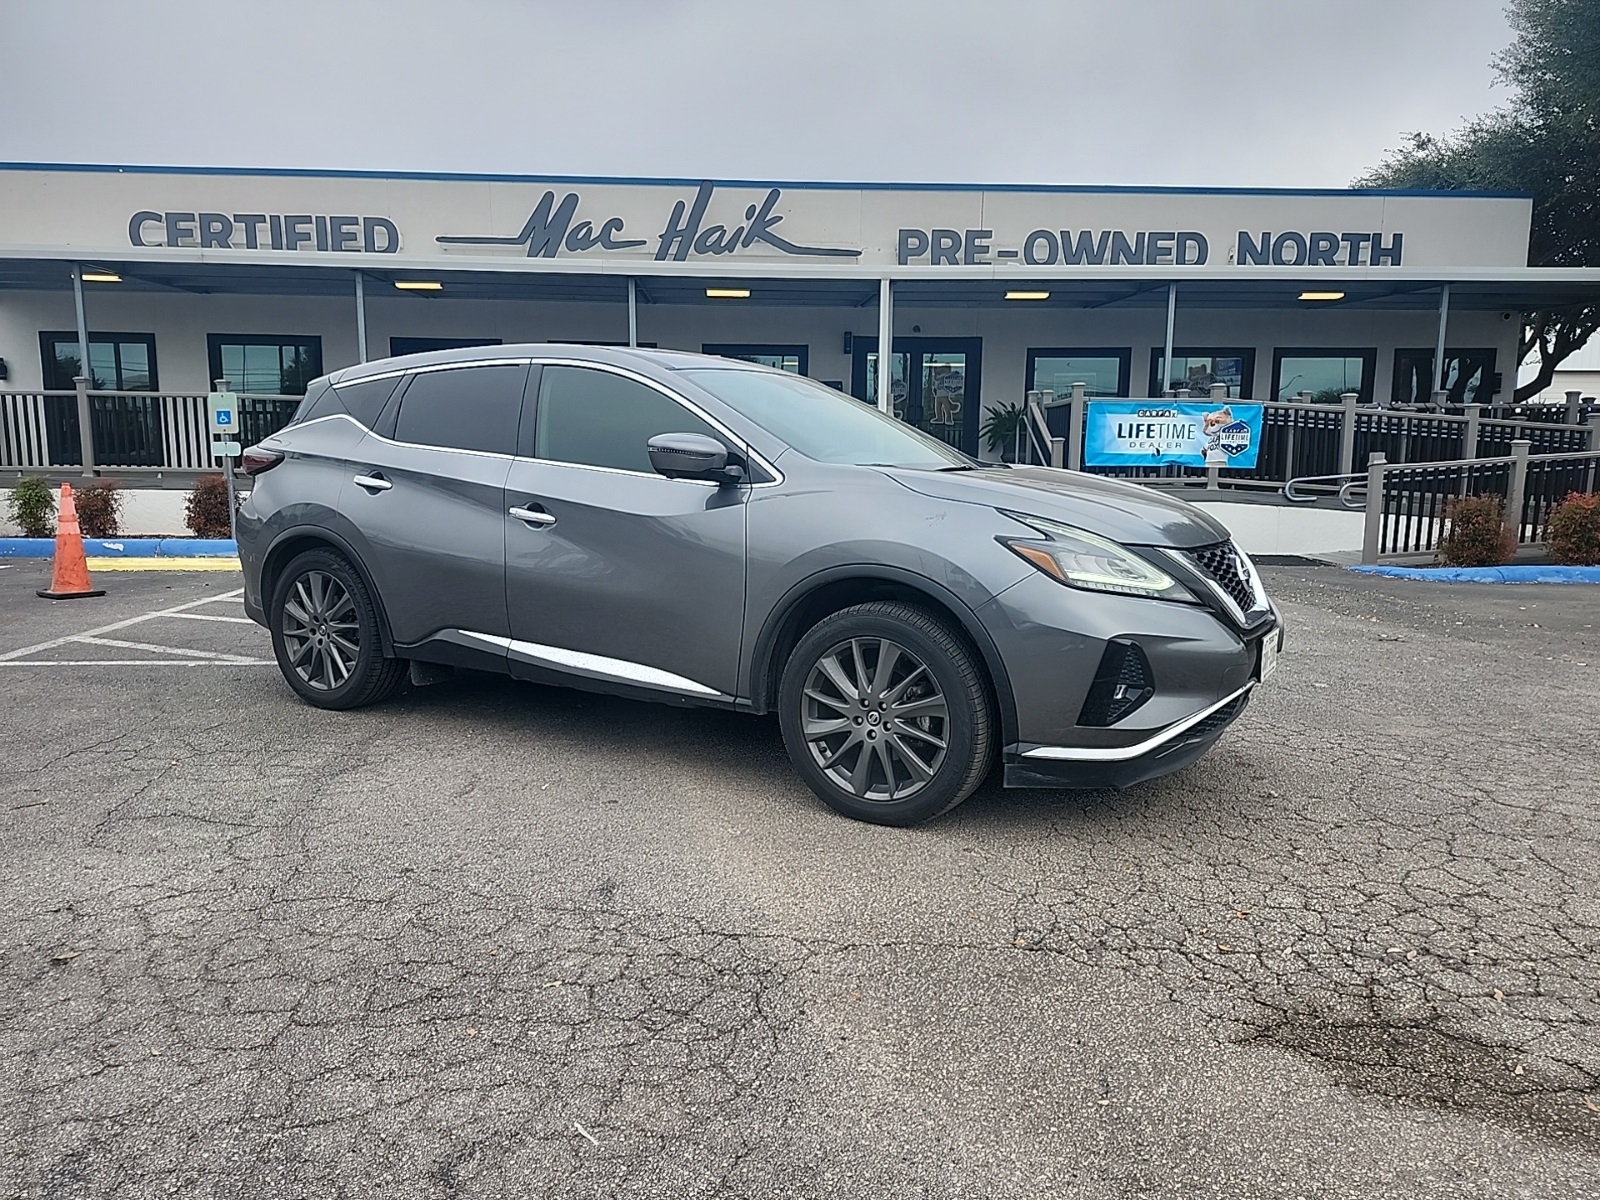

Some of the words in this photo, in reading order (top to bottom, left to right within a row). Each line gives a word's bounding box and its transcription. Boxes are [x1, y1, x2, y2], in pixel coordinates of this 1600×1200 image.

[128, 209, 400, 254] CERTIFIED
[436, 190, 647, 258] Mac
[653, 180, 862, 261] Haik
[897, 228, 1209, 266] PRE-OWNED
[1236, 230, 1404, 267] NORTH
[1137, 409, 1179, 418] CARFAX
[1117, 422, 1196, 440] LIFETIME
[1129, 441, 1182, 449] DEALER
